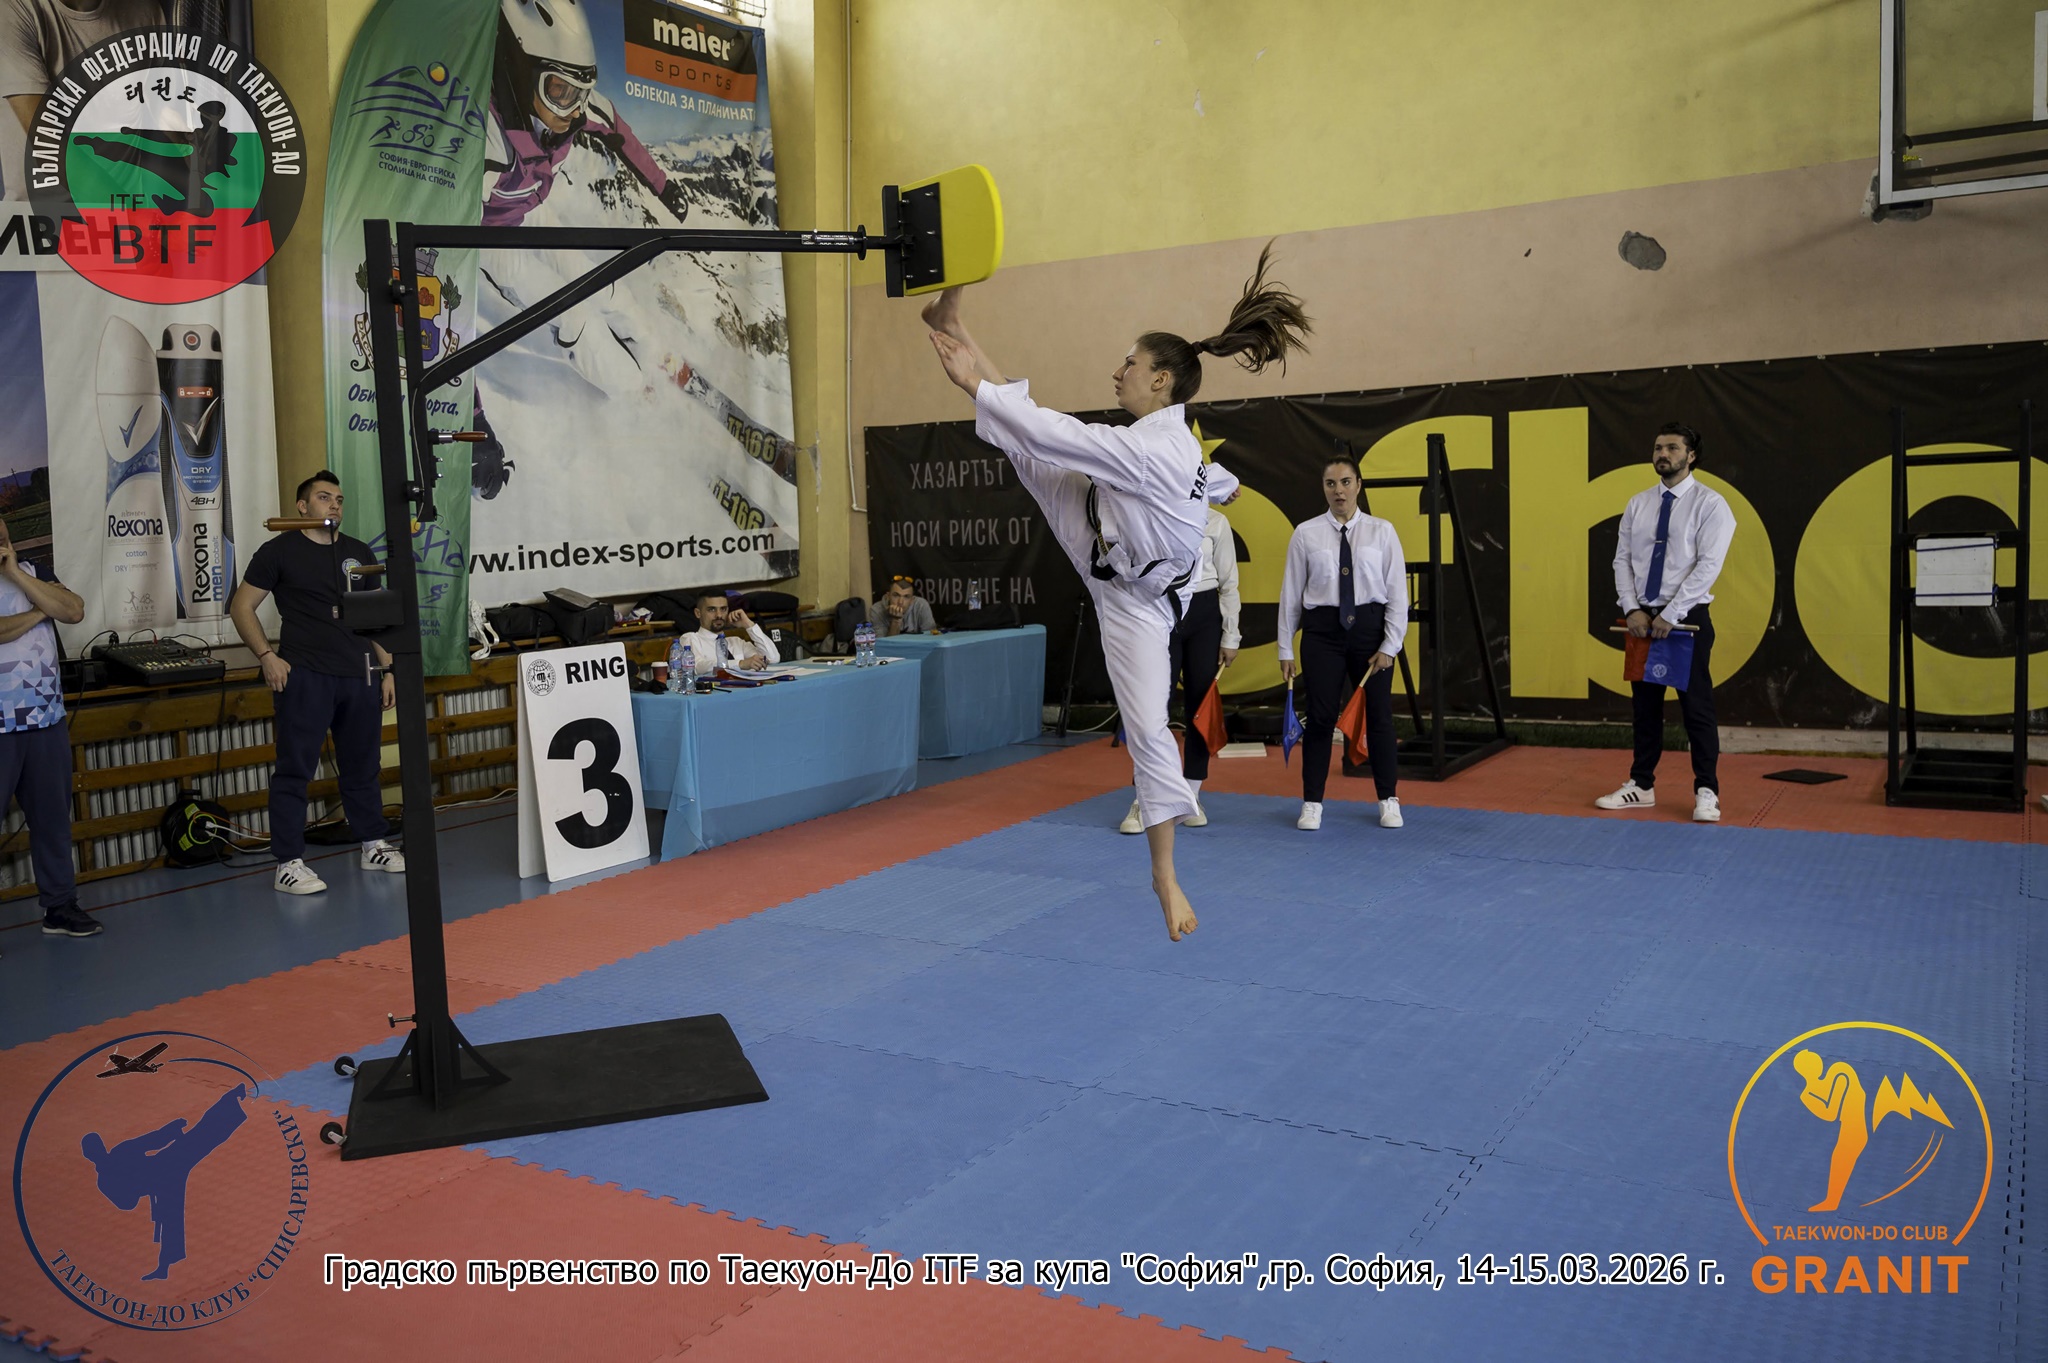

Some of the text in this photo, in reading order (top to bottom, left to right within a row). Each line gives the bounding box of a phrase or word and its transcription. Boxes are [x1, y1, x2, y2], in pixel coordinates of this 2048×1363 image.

[653, 18, 731, 61] maier
[655, 59, 732, 91] sports
[626, 80, 677, 108] ОБЛЕКЛА
[680, 95, 695, 112] ЗА
[378, 161, 456, 190] СТОЛИЦА НА СПОРТА
[191, 466, 212, 474] DRY
[910, 458, 1006, 490] ХАЗАРТЪТ
[190, 496, 216, 506] 48H
[108, 515, 164, 538] Rexona
[891, 516, 1032, 547] НОСИ РИСК ОТ
[125, 550, 148, 558] cotton
[192, 522, 212, 604] Rexona
[212, 565, 223, 602] men
[1010, 577, 1036, 605] НА
[565, 656, 625, 684] RING
[547, 717, 634, 849] 3
